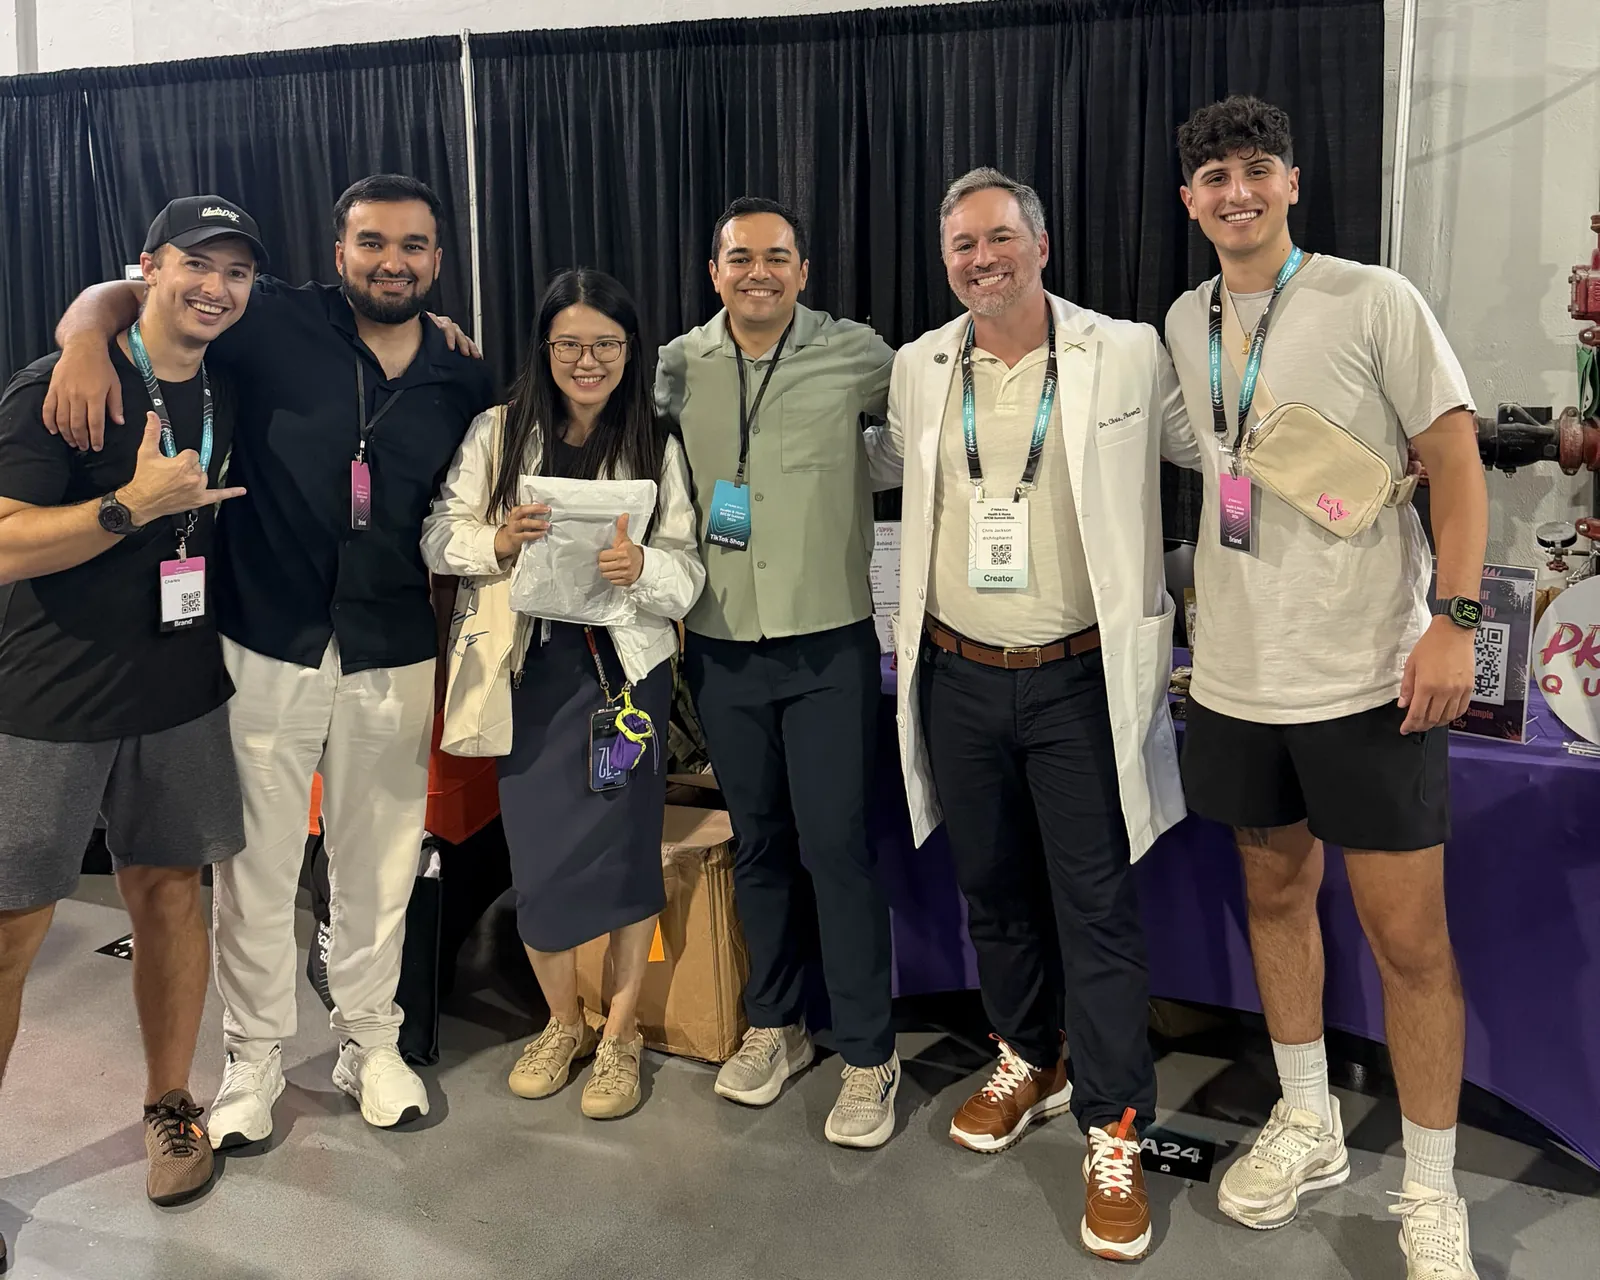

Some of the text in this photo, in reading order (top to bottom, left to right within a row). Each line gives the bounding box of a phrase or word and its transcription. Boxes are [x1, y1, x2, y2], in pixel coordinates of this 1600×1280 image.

[710, 534, 745, 547] TikTok Shop
[984, 574, 1014, 582] Creator
[174, 618, 193, 627] Brand
[1139, 1138, 1203, 1163] A24
